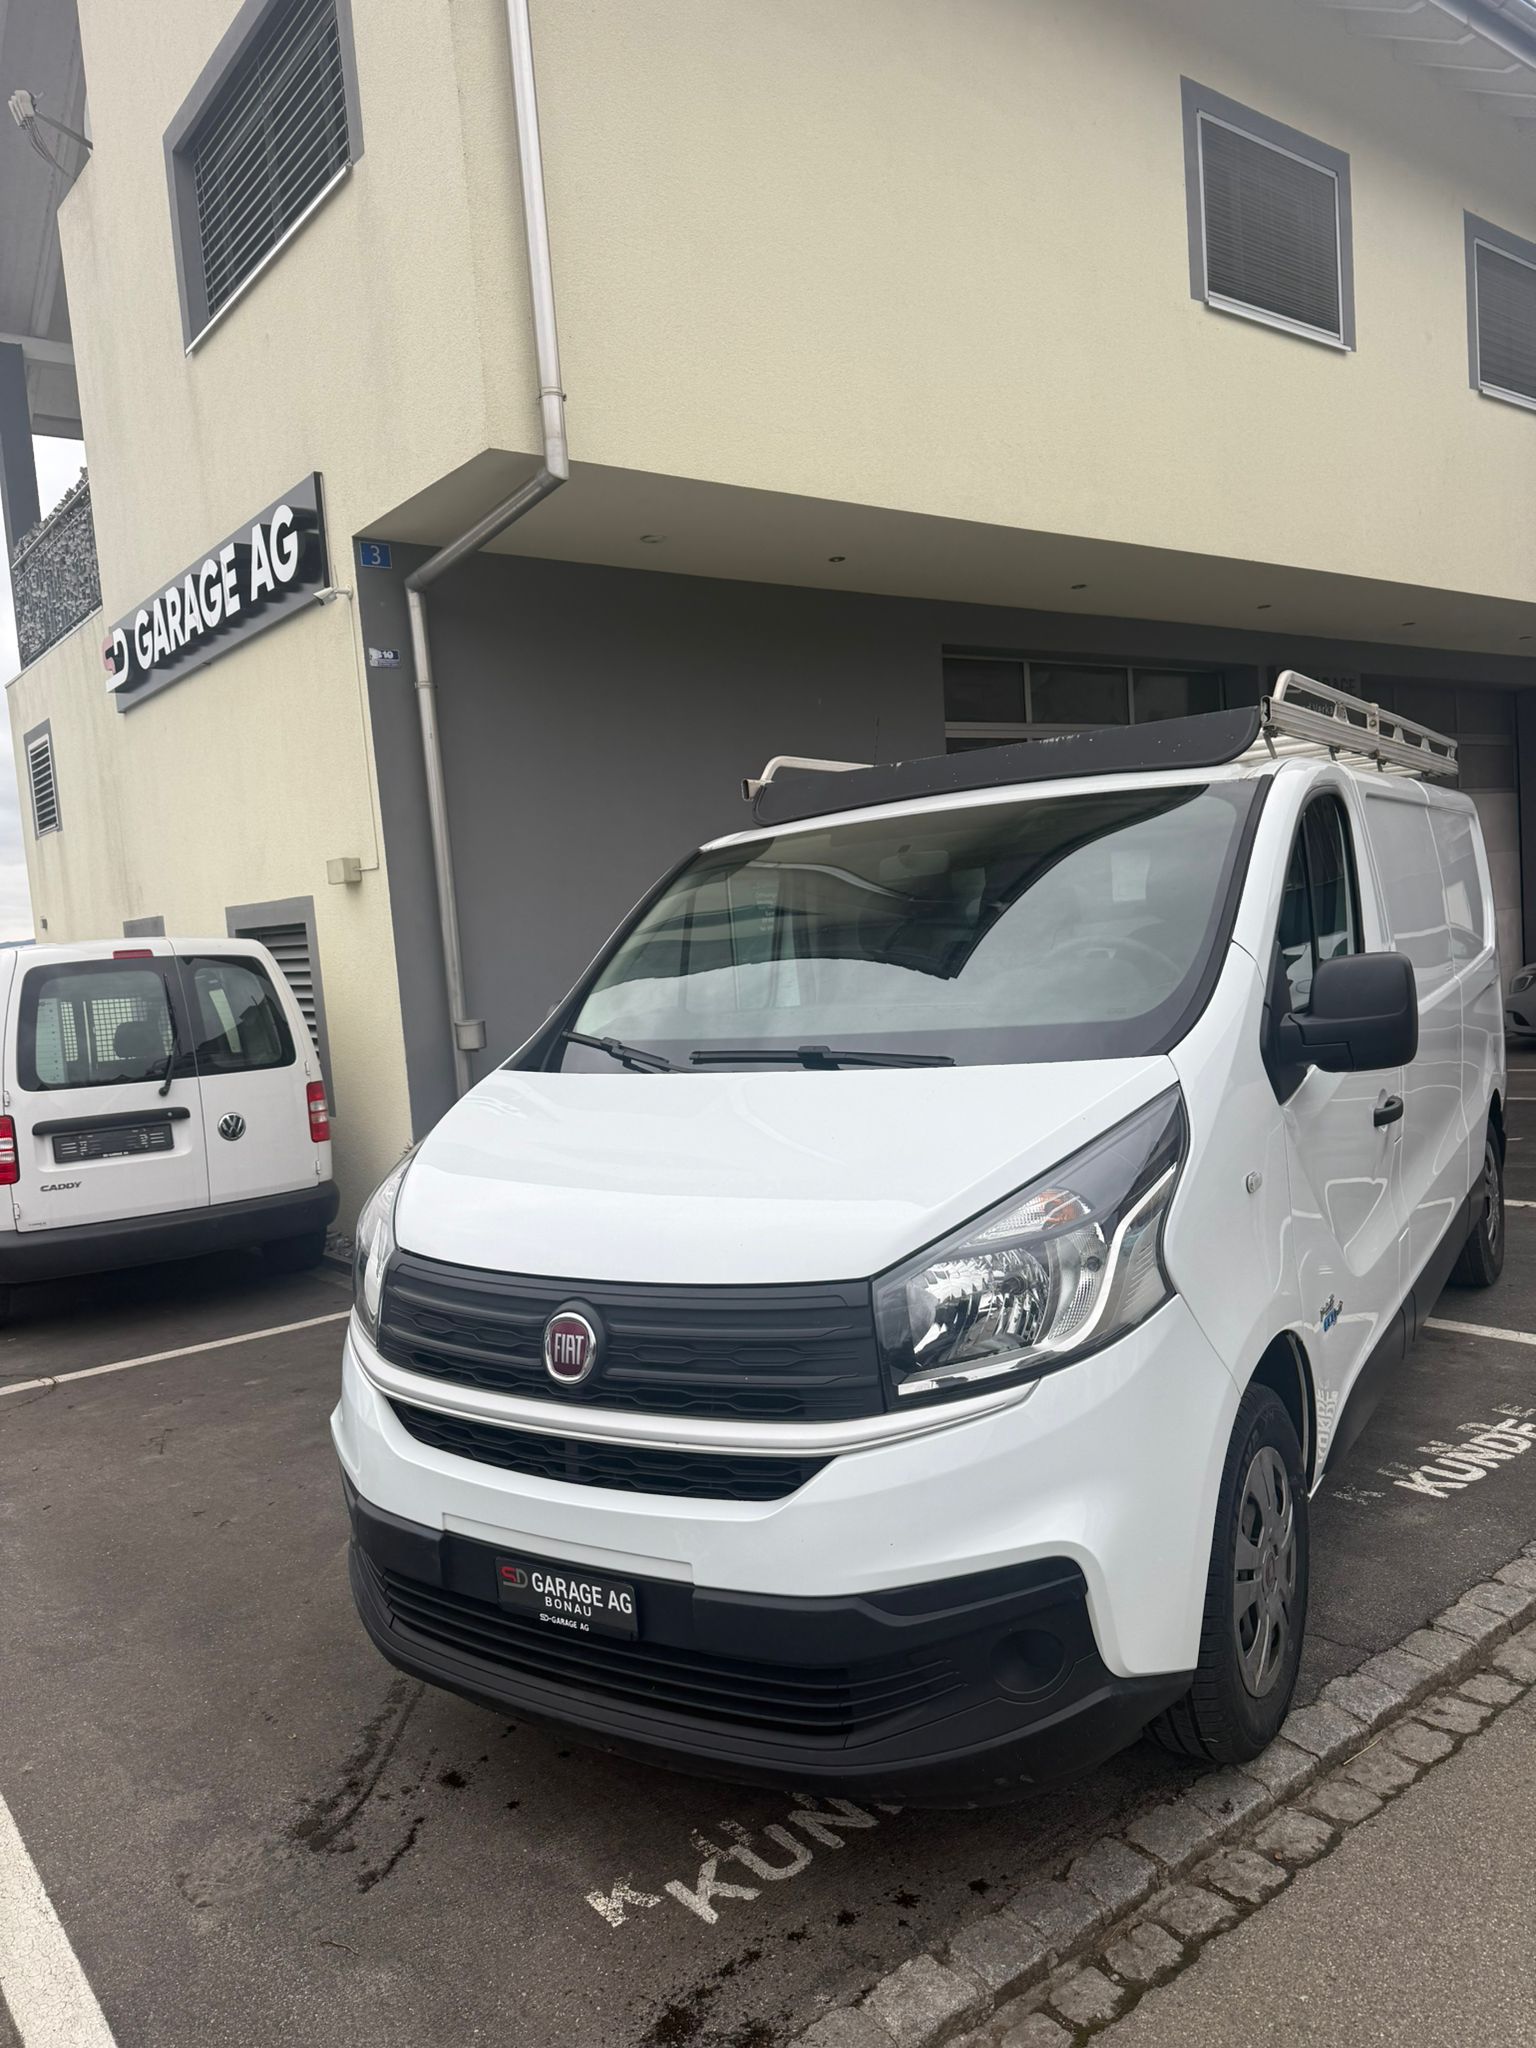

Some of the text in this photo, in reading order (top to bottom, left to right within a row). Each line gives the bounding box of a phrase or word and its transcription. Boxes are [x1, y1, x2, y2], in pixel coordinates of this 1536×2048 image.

[370, 545, 381, 565] 3
[134, 542, 241, 670] GARAGE
[251, 504, 298, 602] AG
[40, 1181, 82, 1193] CADDY
[554, 1332, 585, 1365] FIAT
[501, 1566, 633, 1614] SD GARAGE AG
[544, 1596, 592, 1617] BONAU
[539, 1613, 590, 1632] SD-GARAGE AG
[664, 1795, 904, 1926] KUN
